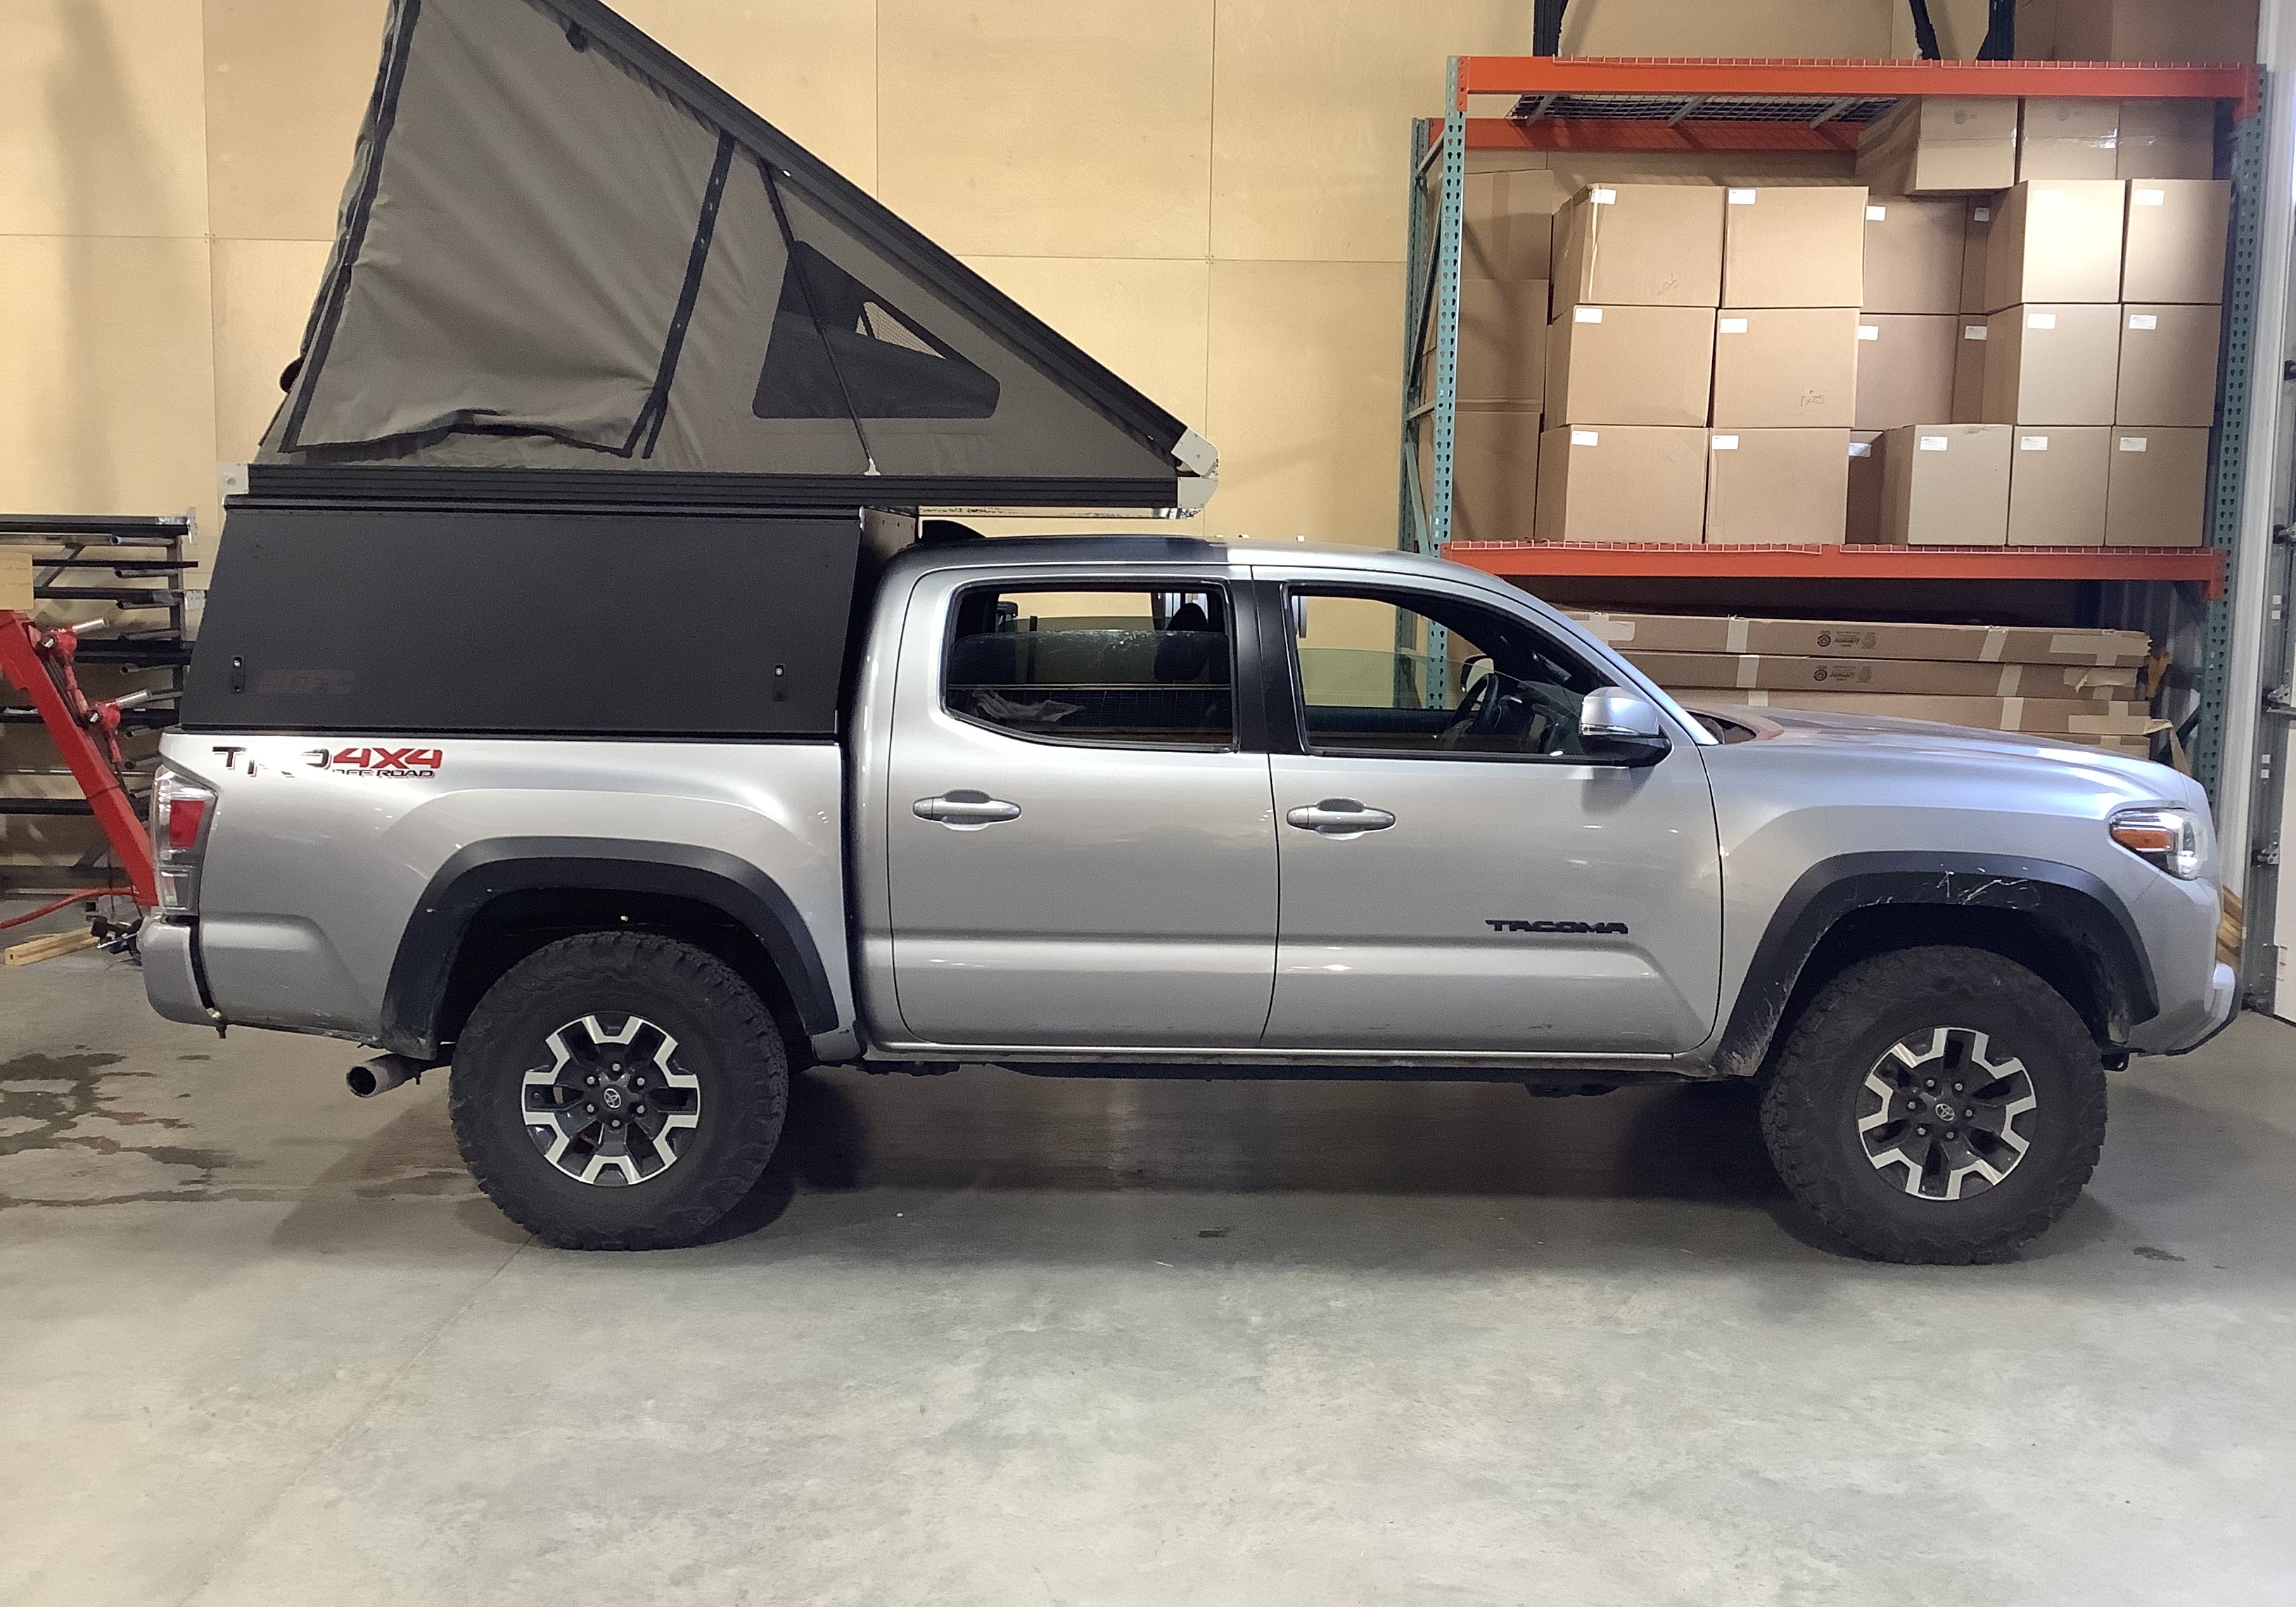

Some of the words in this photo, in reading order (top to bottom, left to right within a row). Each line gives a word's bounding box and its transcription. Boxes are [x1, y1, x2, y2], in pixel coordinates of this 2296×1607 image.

[333, 747, 442, 770] 4X4
[376, 769, 434, 778] ROAD
[1485, 920, 1628, 934] TACOMA
